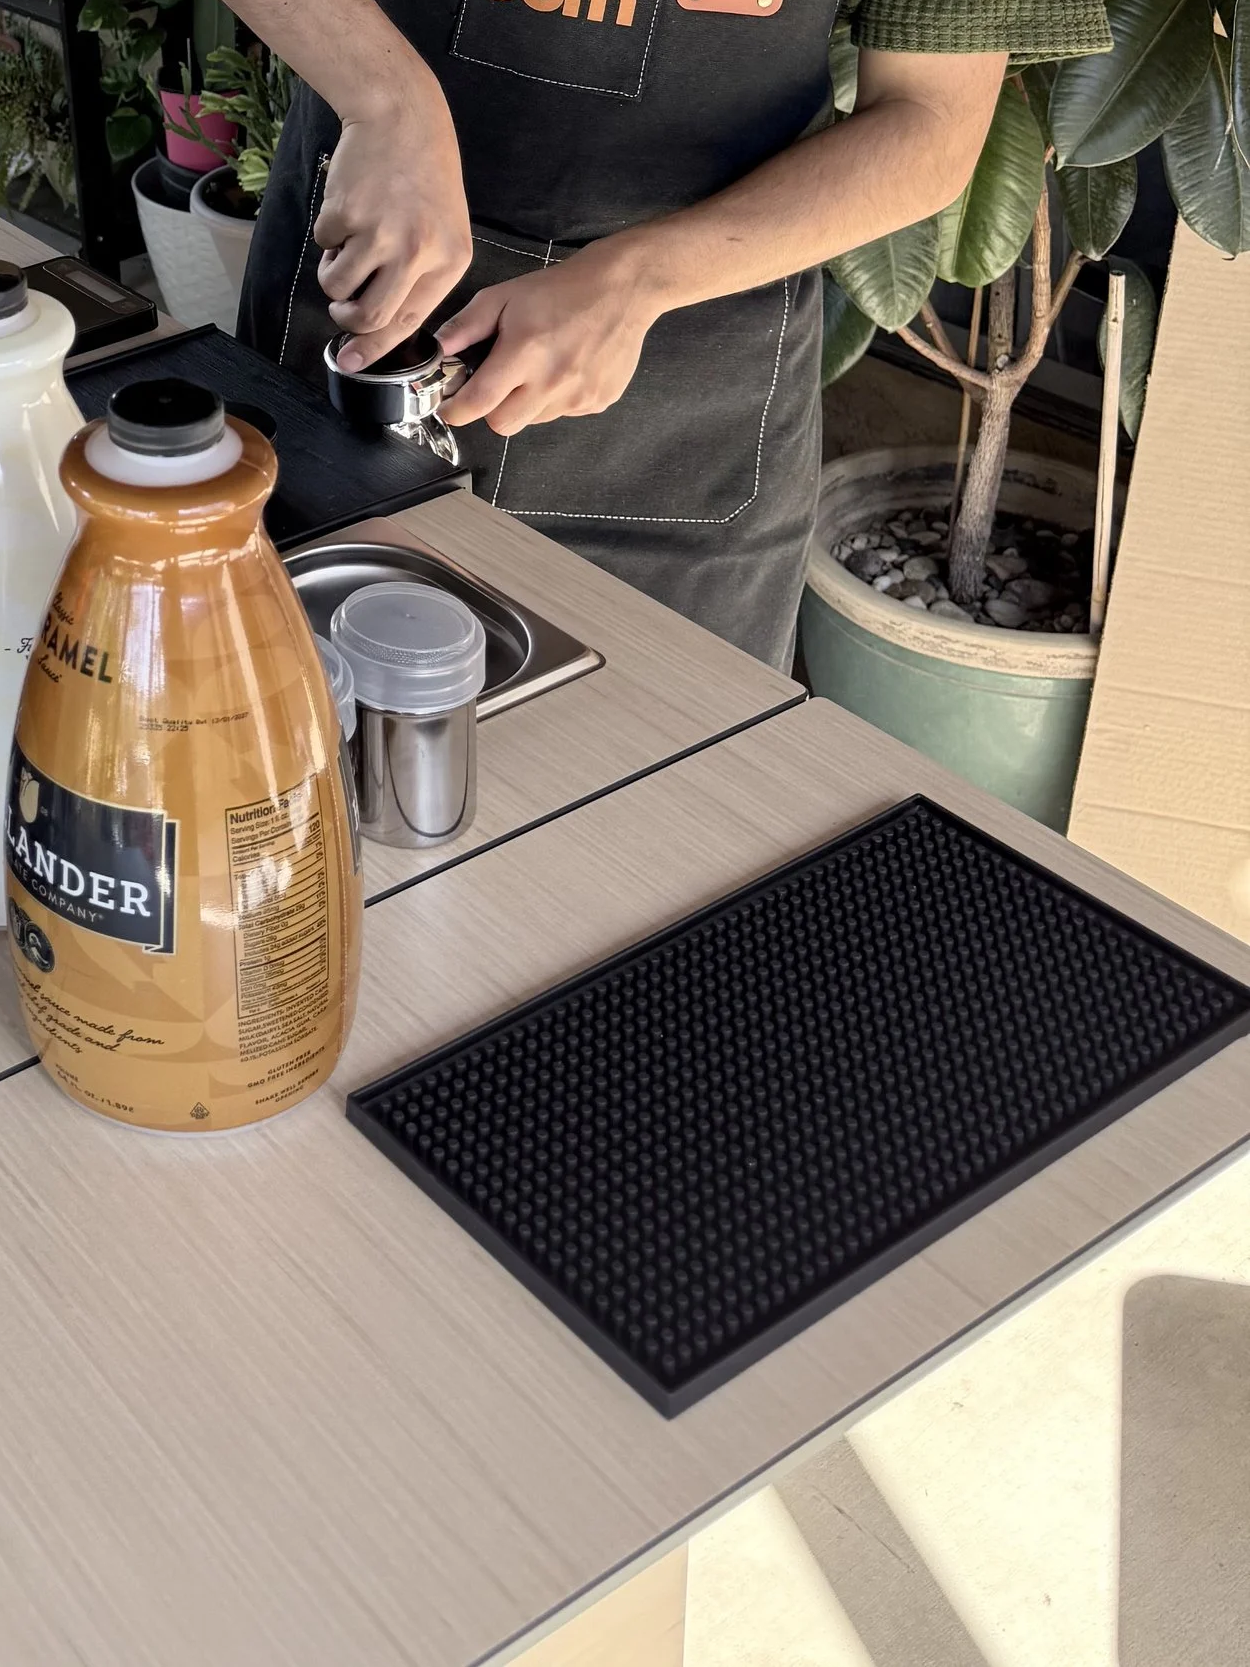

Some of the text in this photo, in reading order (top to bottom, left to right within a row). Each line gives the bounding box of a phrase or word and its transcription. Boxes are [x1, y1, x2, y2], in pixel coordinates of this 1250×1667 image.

[230, 804, 277, 825] Nutrition
[7, 805, 151, 917] LANDER
[73, 1015, 116, 1037] made
[117, 1029, 165, 1046] from
[84, 1035, 121, 1052] and
[267, 1059, 295, 1075] GLUTEN
[247, 1078, 266, 1088] GMO
[267, 1071, 284, 1083] FREE
